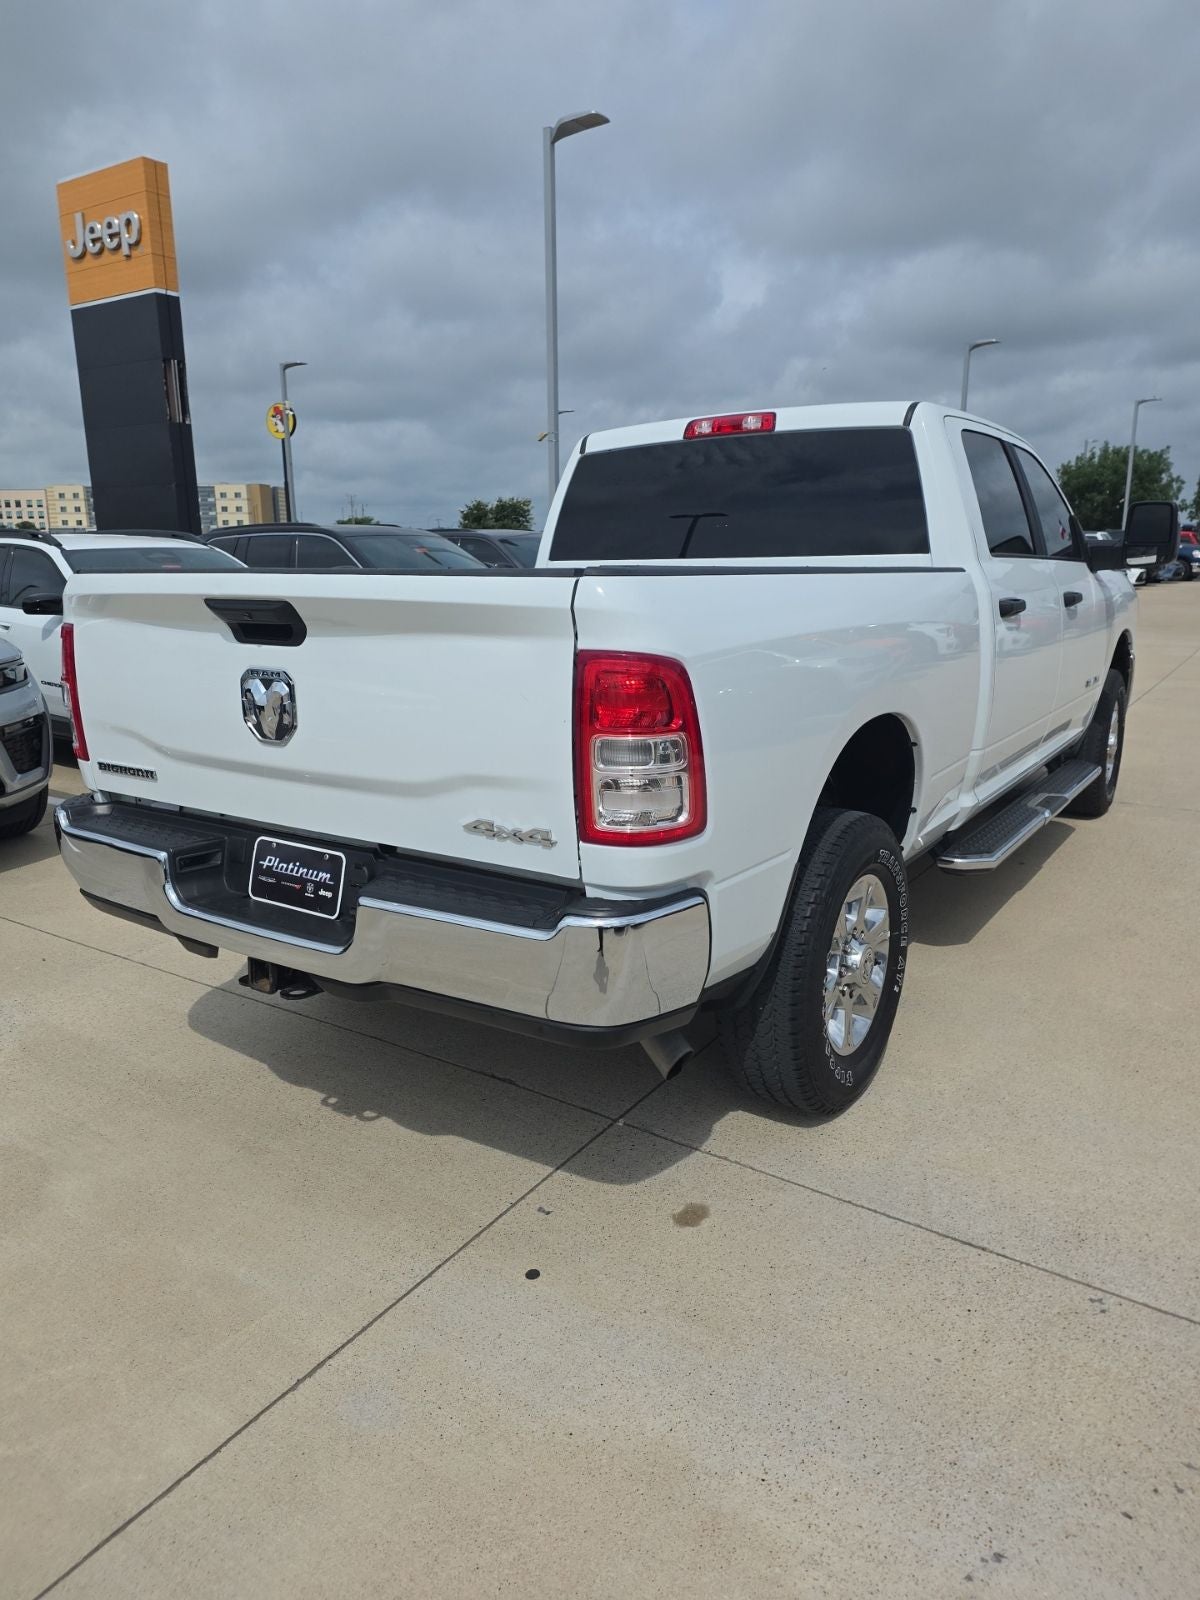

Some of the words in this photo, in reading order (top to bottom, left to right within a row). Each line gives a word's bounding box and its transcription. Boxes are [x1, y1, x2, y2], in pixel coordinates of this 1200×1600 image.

[66, 209, 141, 260] Jeep
[250, 670, 281, 678] RAM
[258, 856, 335, 885] Platinum
[318, 888, 333, 899] Jeep
